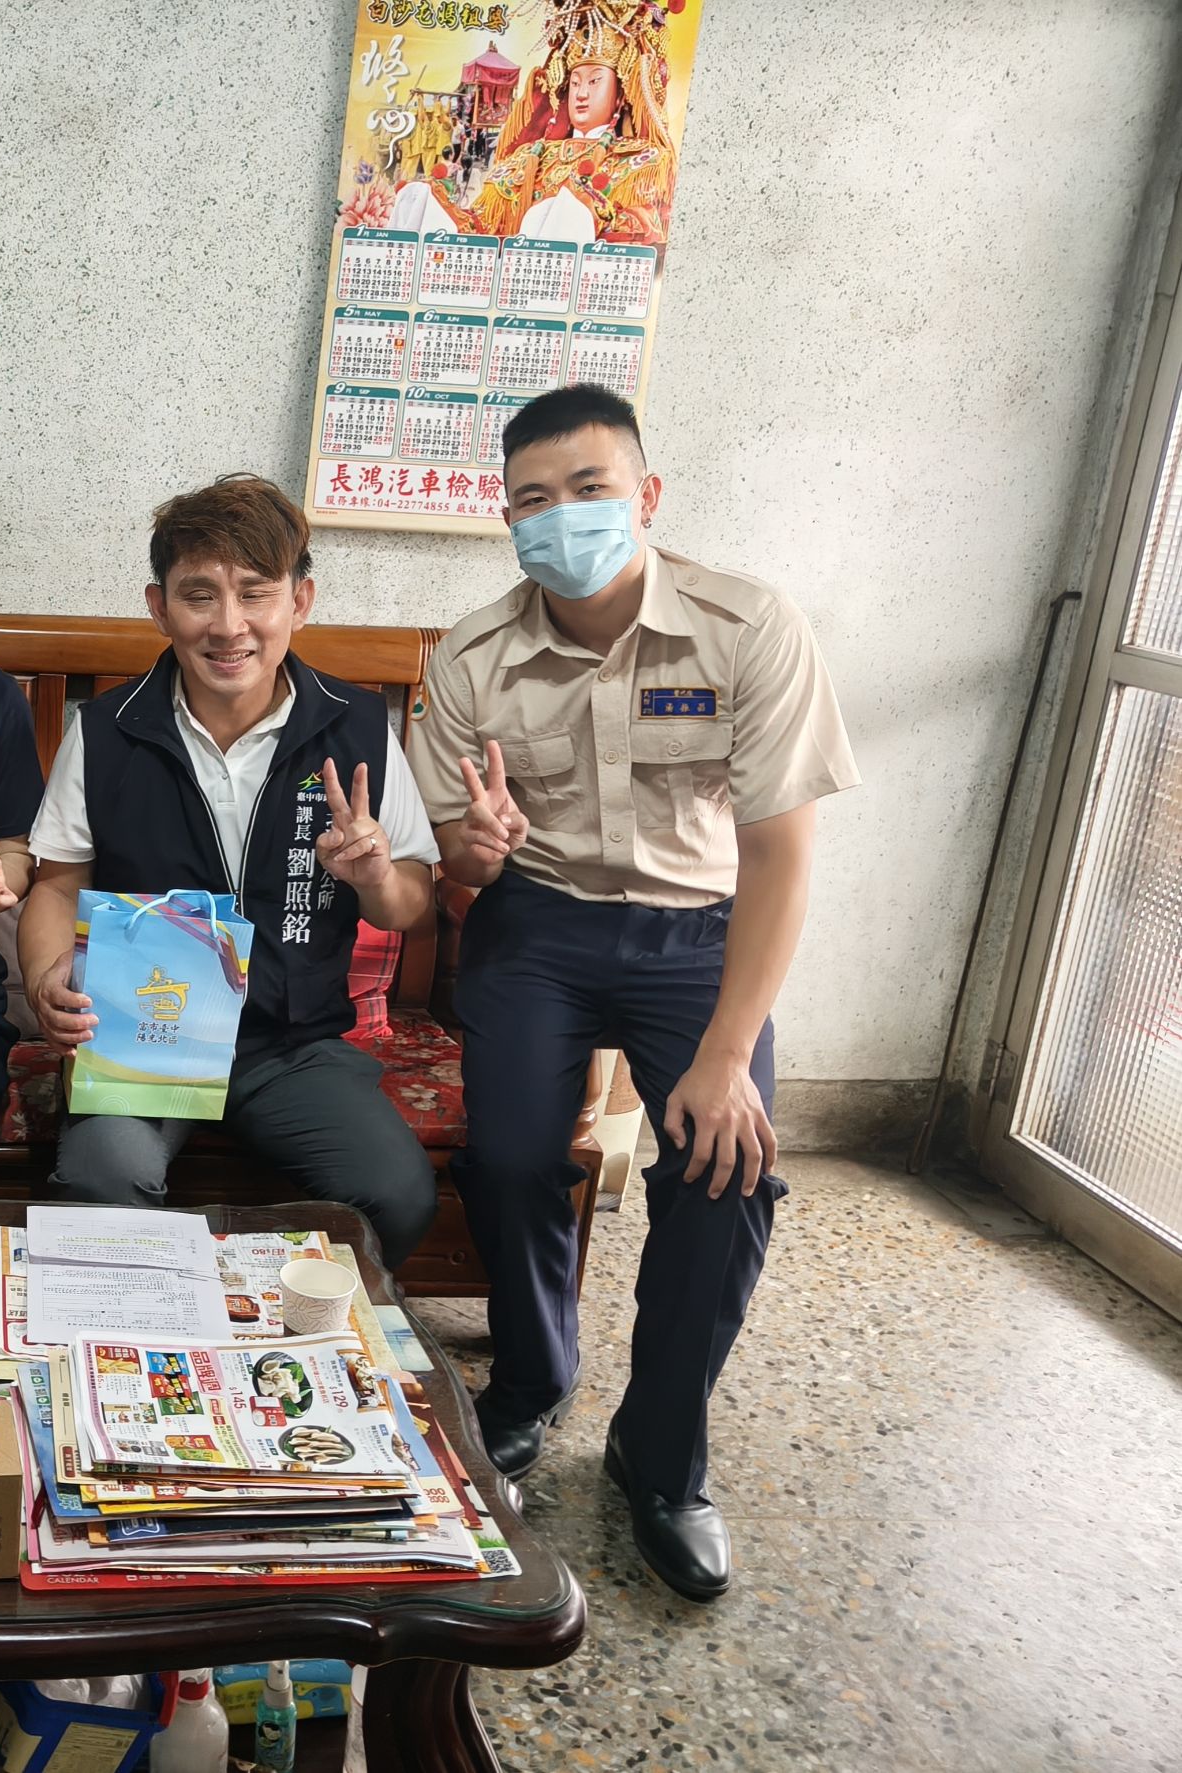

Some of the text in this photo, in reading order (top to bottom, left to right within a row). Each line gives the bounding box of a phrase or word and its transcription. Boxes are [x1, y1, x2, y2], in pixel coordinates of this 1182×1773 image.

[329, 463, 504, 501] 長鴻汽車檢驗
[294, 805, 313, 841] 課長
[281, 847, 315, 944] 劉照銘
[189, 1351, 222, 1392] 品牌週
[329, 1385, 349, 1409] $129
[46, 1576, 99, 1584] CALENDAR
